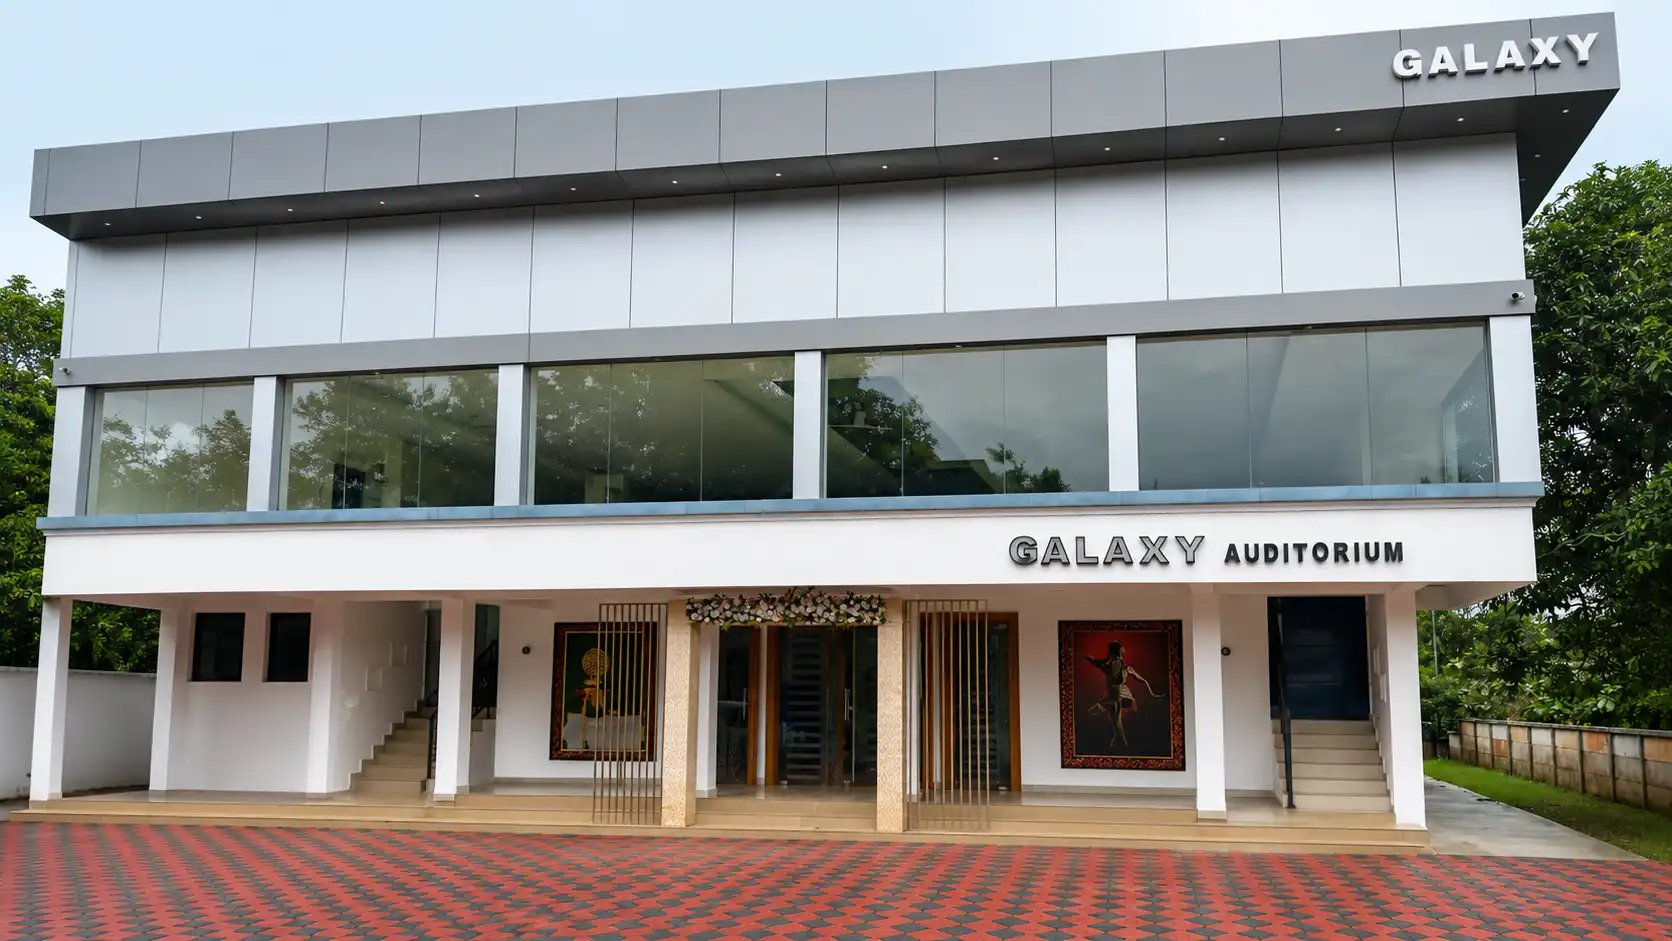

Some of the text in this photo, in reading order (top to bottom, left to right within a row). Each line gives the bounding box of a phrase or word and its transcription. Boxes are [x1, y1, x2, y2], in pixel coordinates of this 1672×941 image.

[1392, 32, 1599, 79] GALAXY
[1009, 535, 1404, 565] GALAXY AUDITORIUM
